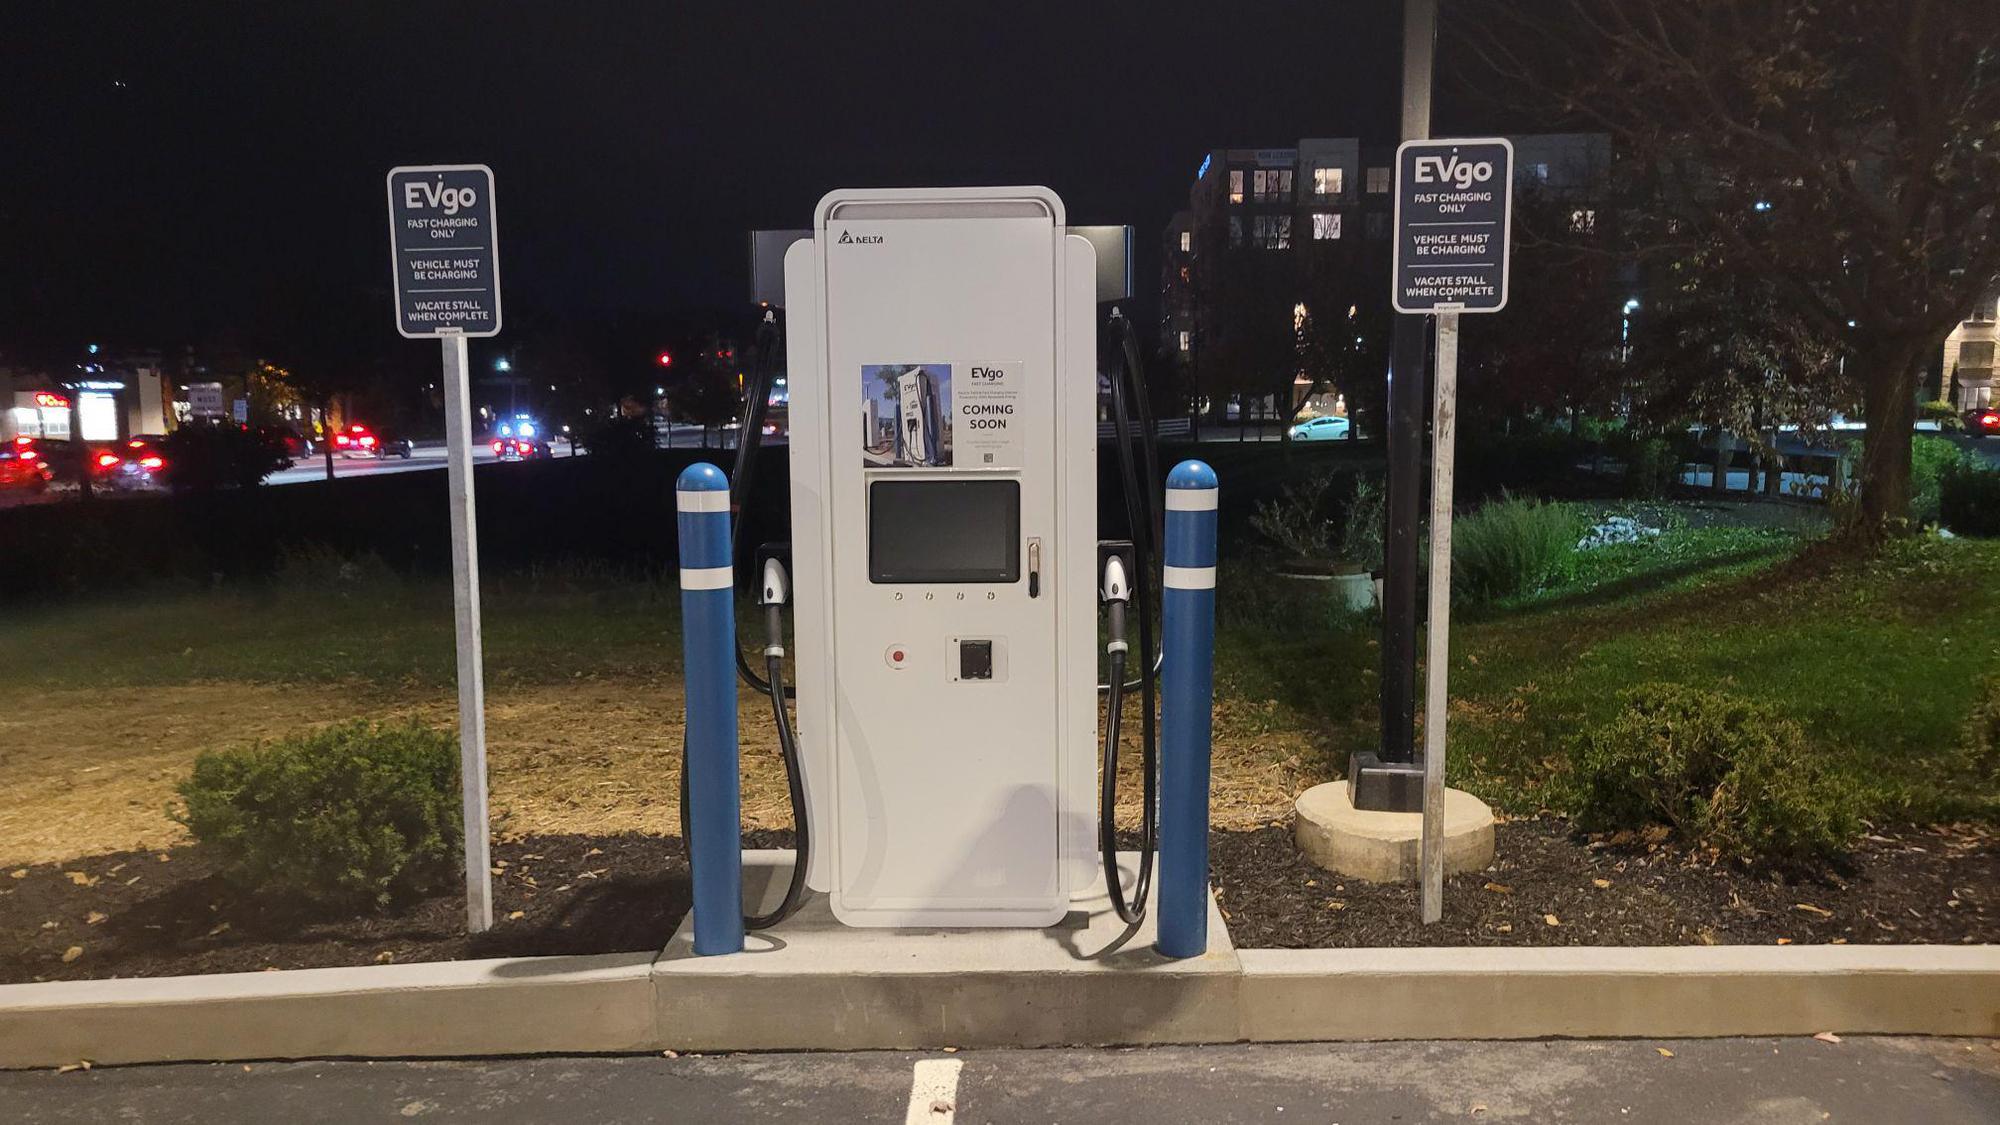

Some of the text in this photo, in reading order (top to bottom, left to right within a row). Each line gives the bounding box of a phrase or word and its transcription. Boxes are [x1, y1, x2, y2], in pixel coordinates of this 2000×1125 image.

[1415, 155, 1493, 189] EVgo
[404, 181, 477, 215] EVgo
[1414, 192, 1492, 203] FAST CHARGING
[1438, 204, 1466, 213] ONLY
[407, 217, 478, 229] FAST CHARGING
[430, 229, 456, 239] ONLY
[1413, 233, 1490, 245] VEHICLE MUST
[1416, 245, 1486, 255] BE CHARGING
[410, 259, 480, 270] VEHICLE MUST
[414, 269, 478, 280] BE CHARGING
[1414, 276, 1486, 286] VACATE STALL
[1405, 286, 1494, 297] WHEN COMPLETE
[414, 300, 480, 311] VACATE STALL
[408, 311, 489, 321] WHEN COMPLETE
[971, 367, 1003, 381] EVgo
[962, 404, 1014, 415] COMING
[969, 419, 1007, 430] SOON
